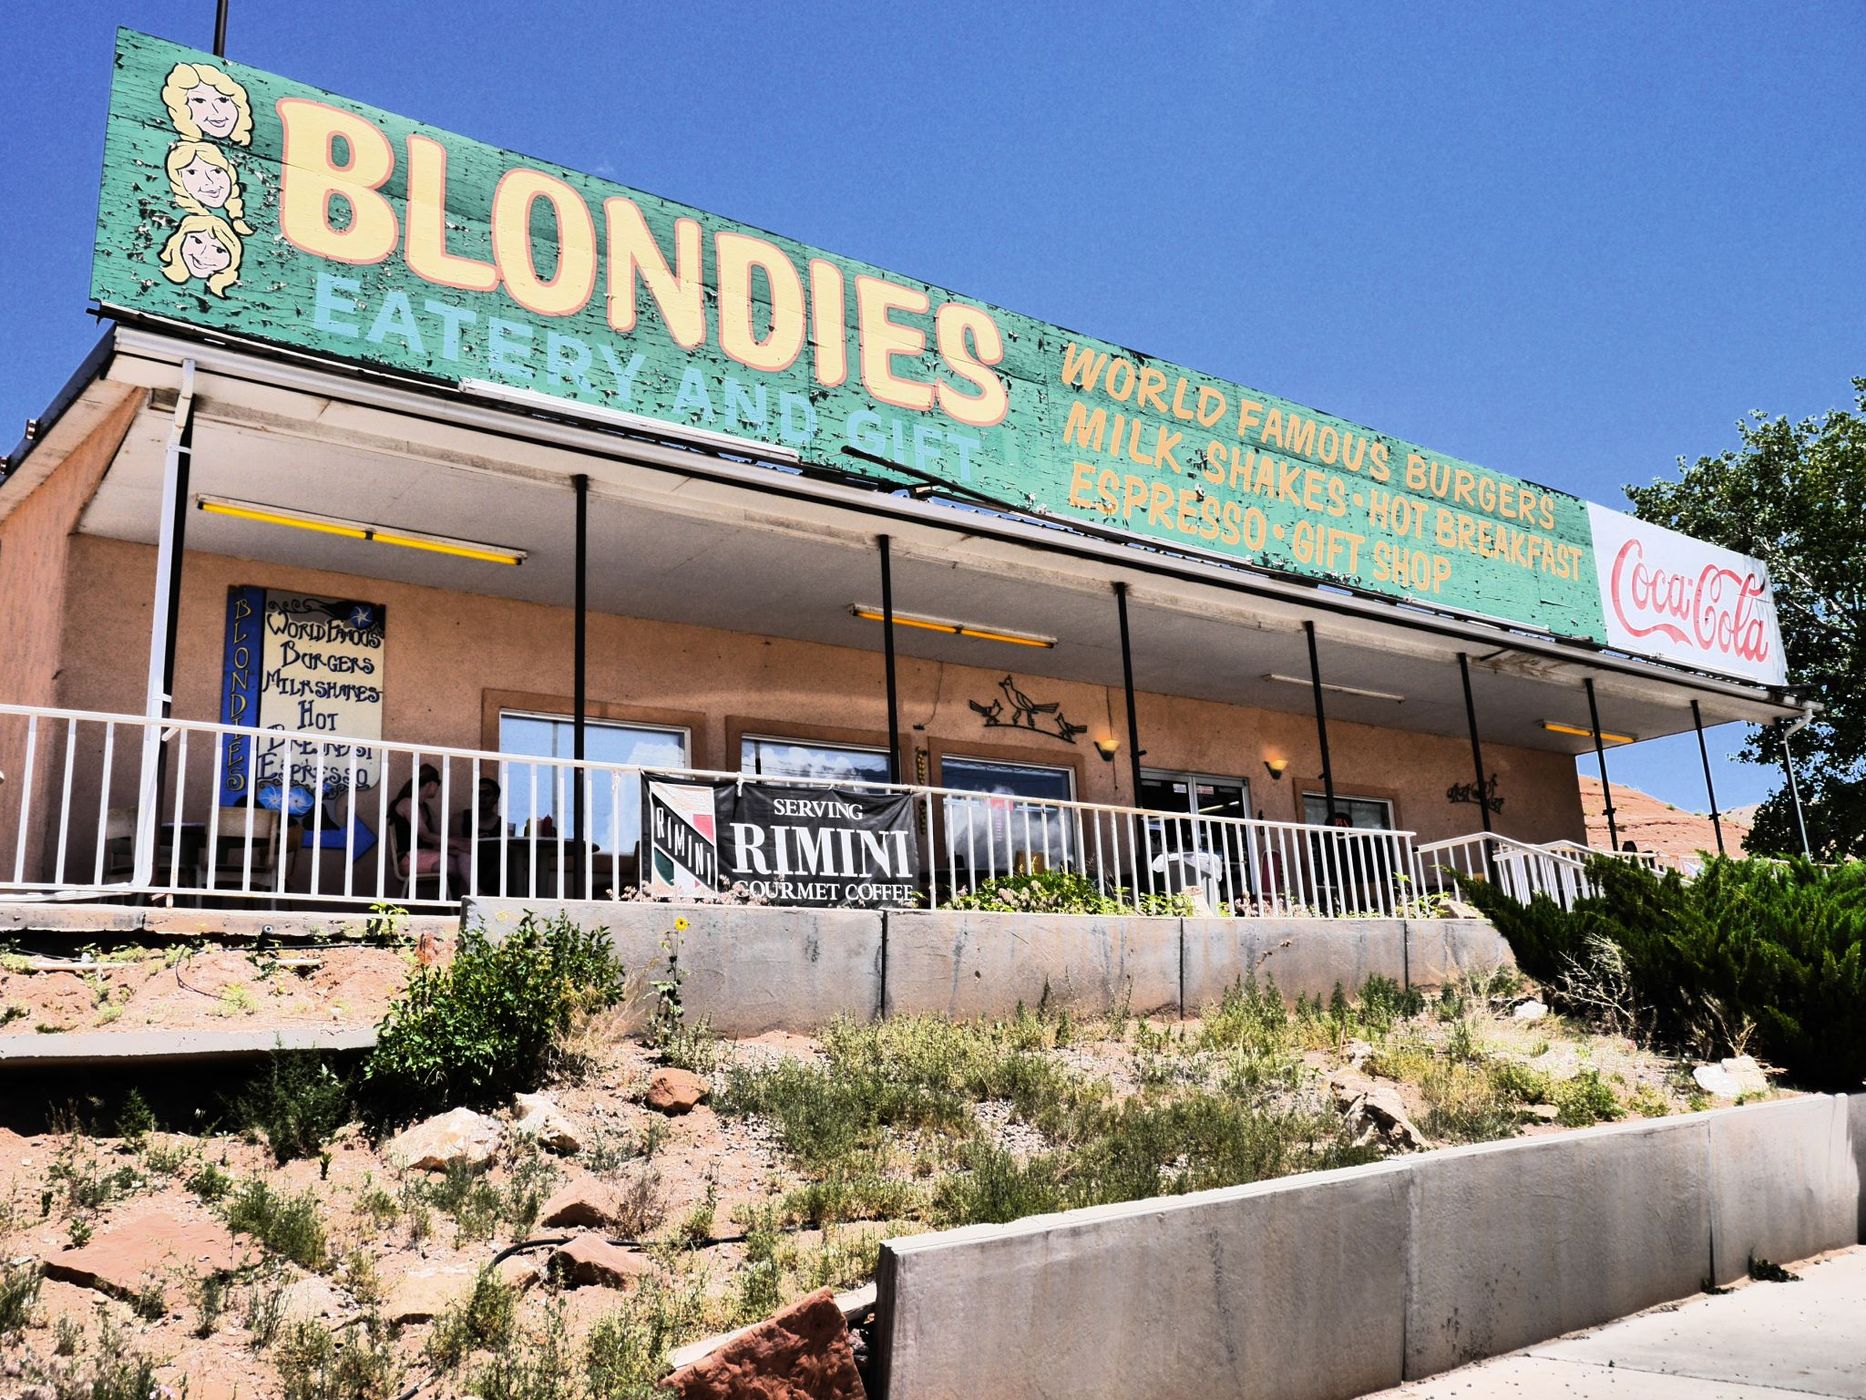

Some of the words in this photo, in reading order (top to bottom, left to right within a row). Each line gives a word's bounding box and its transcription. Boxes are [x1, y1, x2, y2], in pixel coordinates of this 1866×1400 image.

[275, 96, 1009, 427] BLONDIES
[313, 271, 646, 402] EATERY
[672, 367, 818, 443] AND
[846, 409, 980, 481] GIFT
[1061, 342, 1227, 427] WORLD
[1237, 398, 1391, 481] FAMOUS
[1406, 453, 1556, 530] BURGERS
[1063, 400, 1183, 475] MILK
[1202, 440, 1346, 517] SHAKES
[1368, 488, 1429, 539] HOT
[1435, 508, 1582, 581] BREAKFAST
[1069, 460, 1267, 551] ESPRESSO
[1292, 520, 1365, 574] GIFT
[1373, 540, 1452, 593] SHOP
[1610, 538, 1768, 662] Coca-Cola
[656, 807, 711, 885] RIMINI
[729, 822, 913, 878] RIMINI
[773, 798, 863, 820] SERVING
[733, 879, 840, 901] GOURMET
[845, 882, 914, 902] COFFEE
